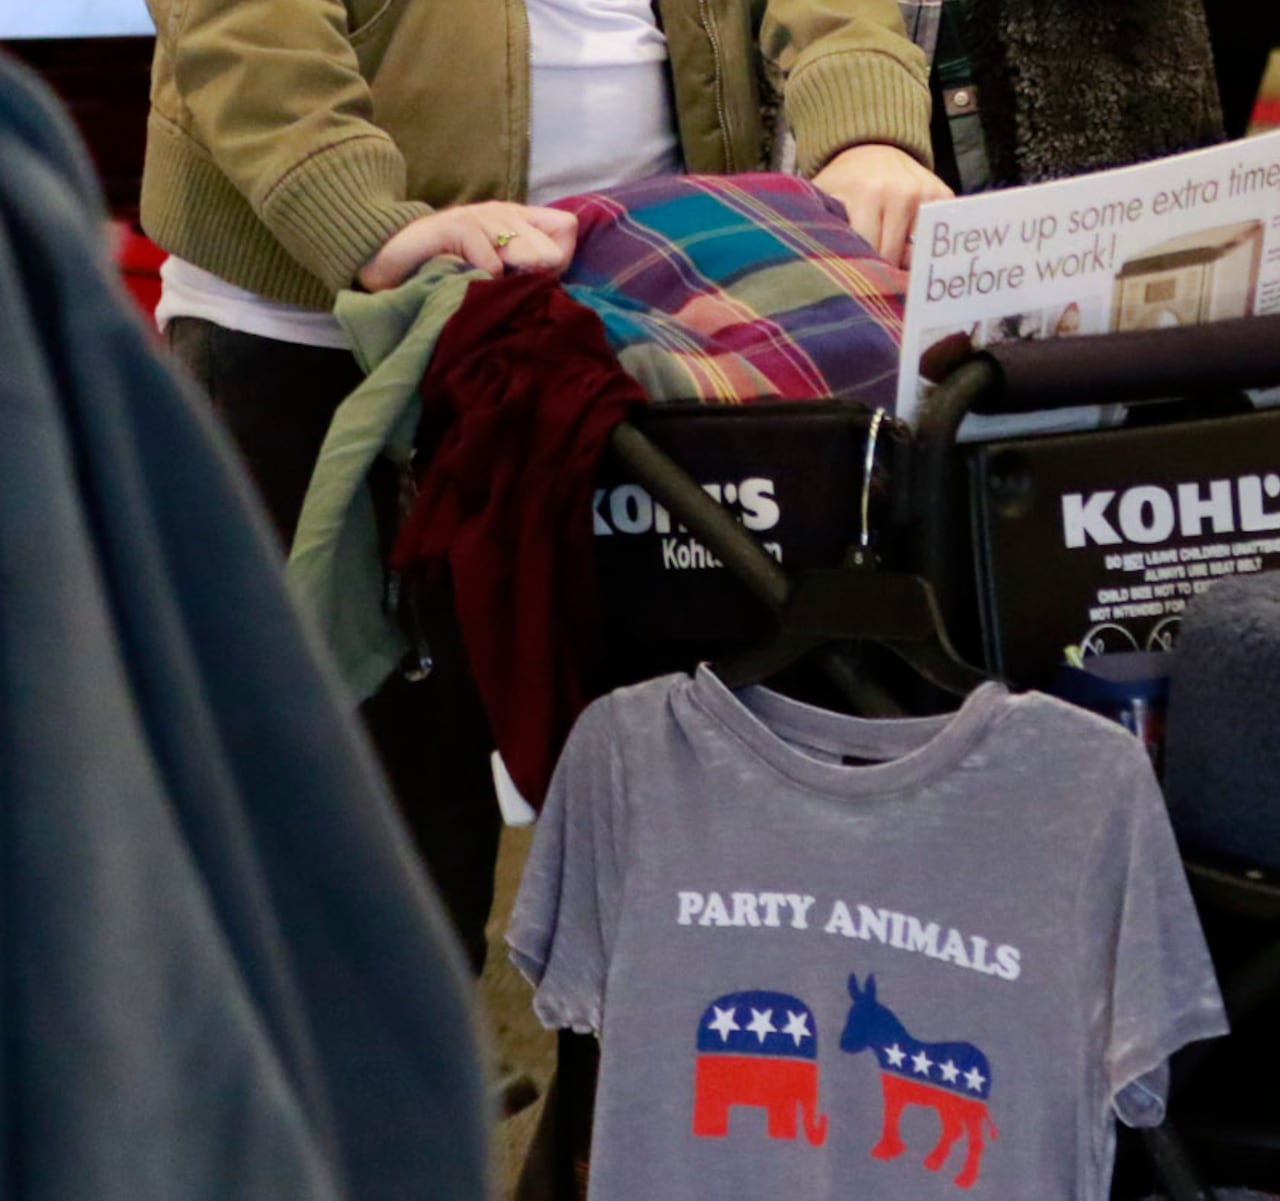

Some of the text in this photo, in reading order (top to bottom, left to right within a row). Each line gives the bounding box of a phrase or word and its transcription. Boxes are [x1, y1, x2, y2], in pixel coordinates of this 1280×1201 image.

[931, 219, 1009, 260] Brew
[1021, 215, 1057, 247] up
[1067, 195, 1143, 233] some
[1153, 179, 1219, 217] extra
[926, 233, 1117, 302] before work!
[677, 891, 1021, 982] PARTY ANIMALS
